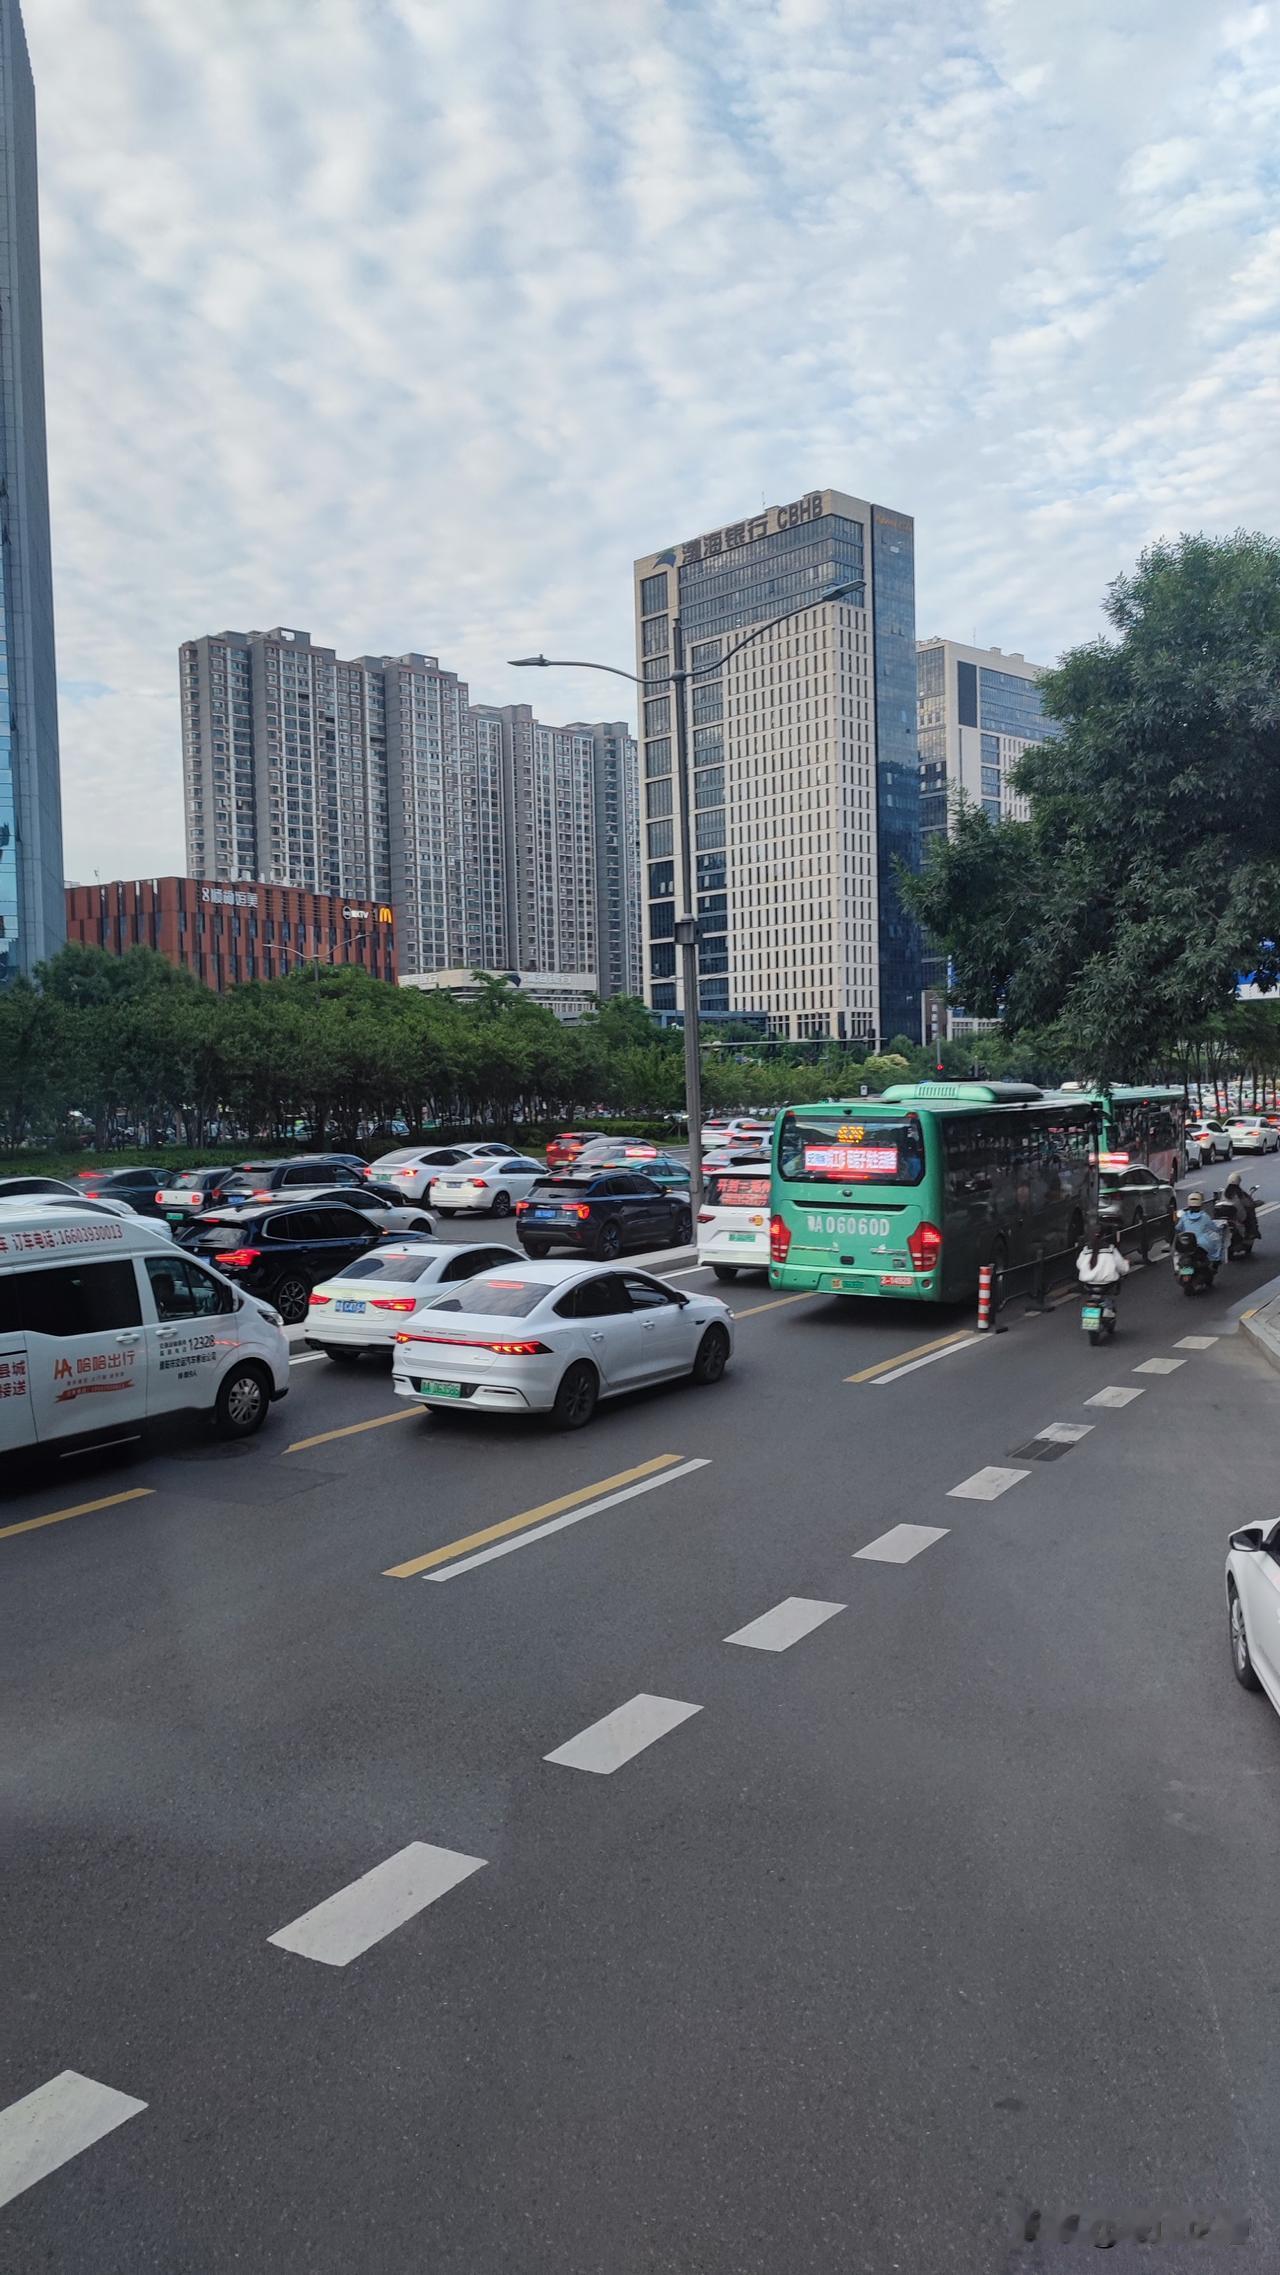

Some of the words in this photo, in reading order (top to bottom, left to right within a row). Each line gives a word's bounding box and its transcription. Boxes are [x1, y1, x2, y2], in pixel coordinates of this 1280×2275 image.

[776, 495, 823, 529] CBHB
[188, 1334, 216, 1351] 12328
[77, 1350, 135, 1374] 哈哈出行
